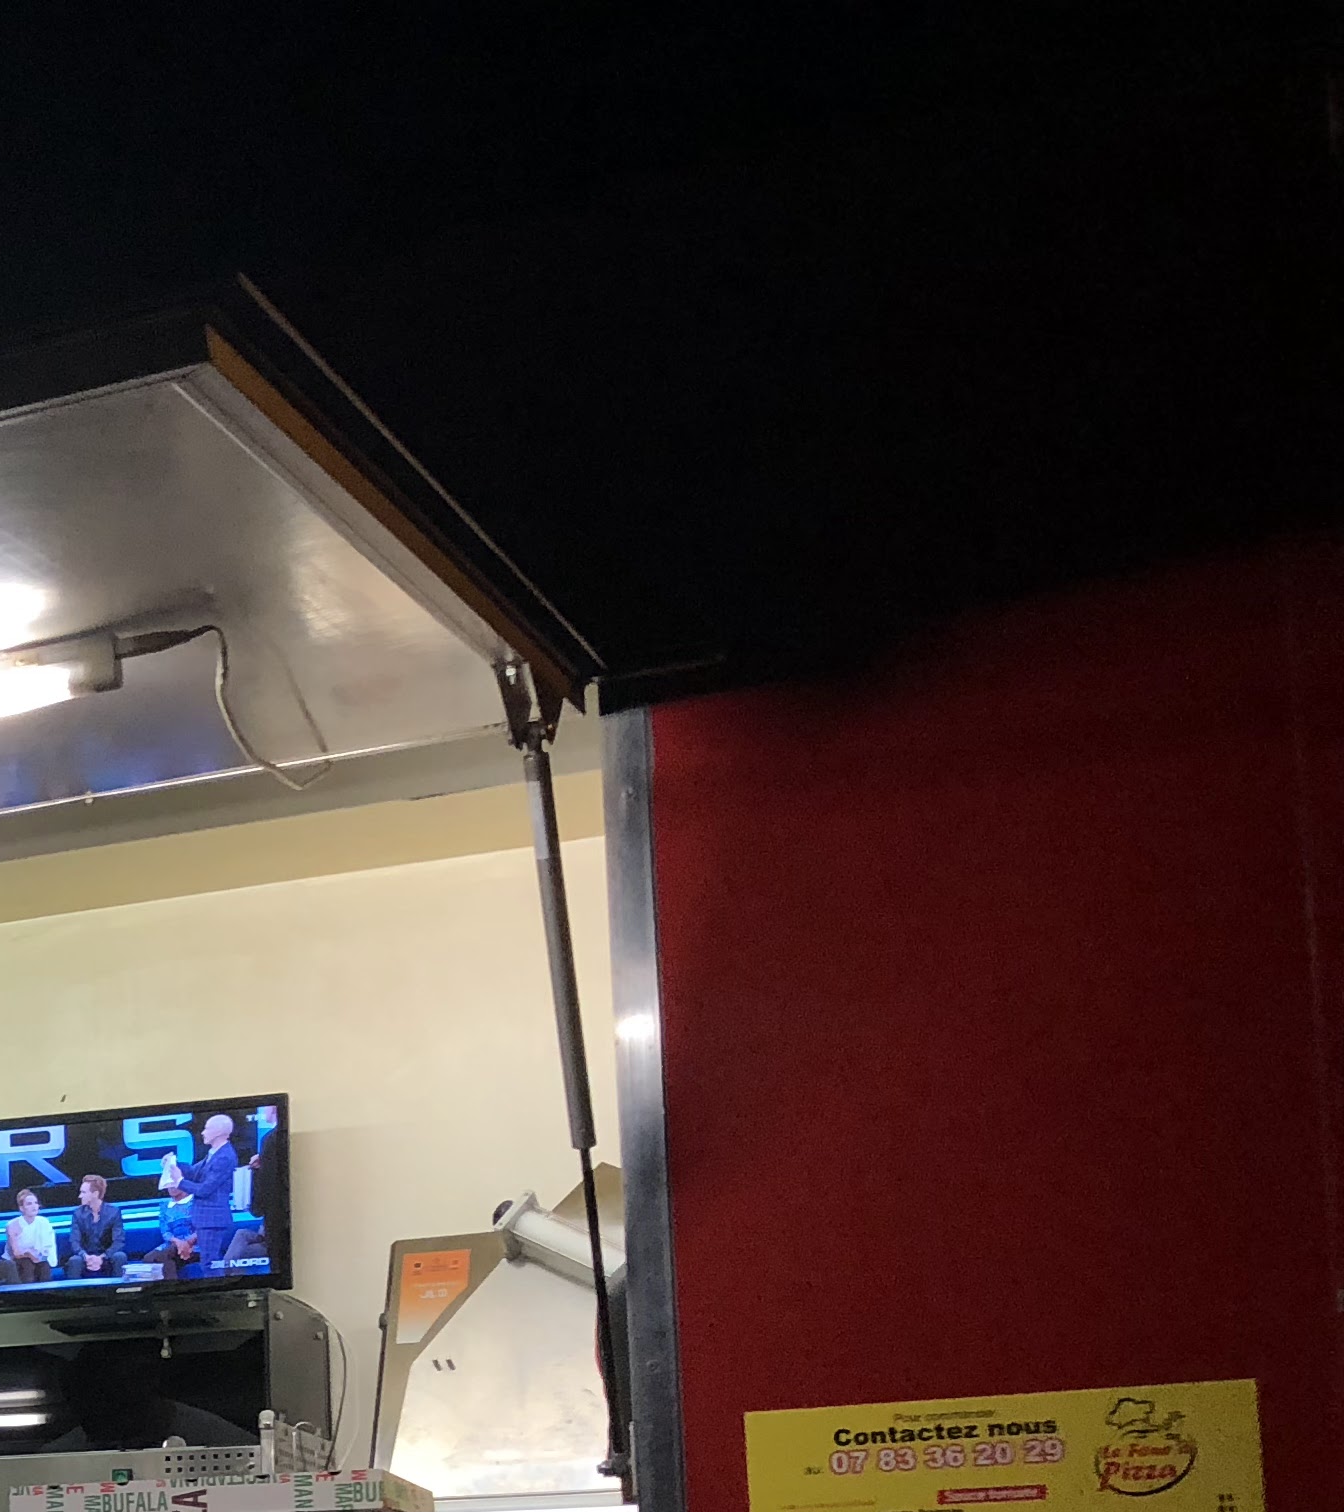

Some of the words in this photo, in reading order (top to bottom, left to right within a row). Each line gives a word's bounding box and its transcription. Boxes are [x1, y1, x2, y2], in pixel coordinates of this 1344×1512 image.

[833, 1423, 979, 1446] Contactez
[987, 1418, 1058, 1437] nous
[830, 1450, 868, 1474] 07
[878, 1447, 917, 1472] 83
[924, 1445, 966, 1469] 36
[972, 1441, 1014, 1466] 20
[1022, 1438, 1064, 1464] 29
[1097, 1462, 1177, 1491] Pizza
